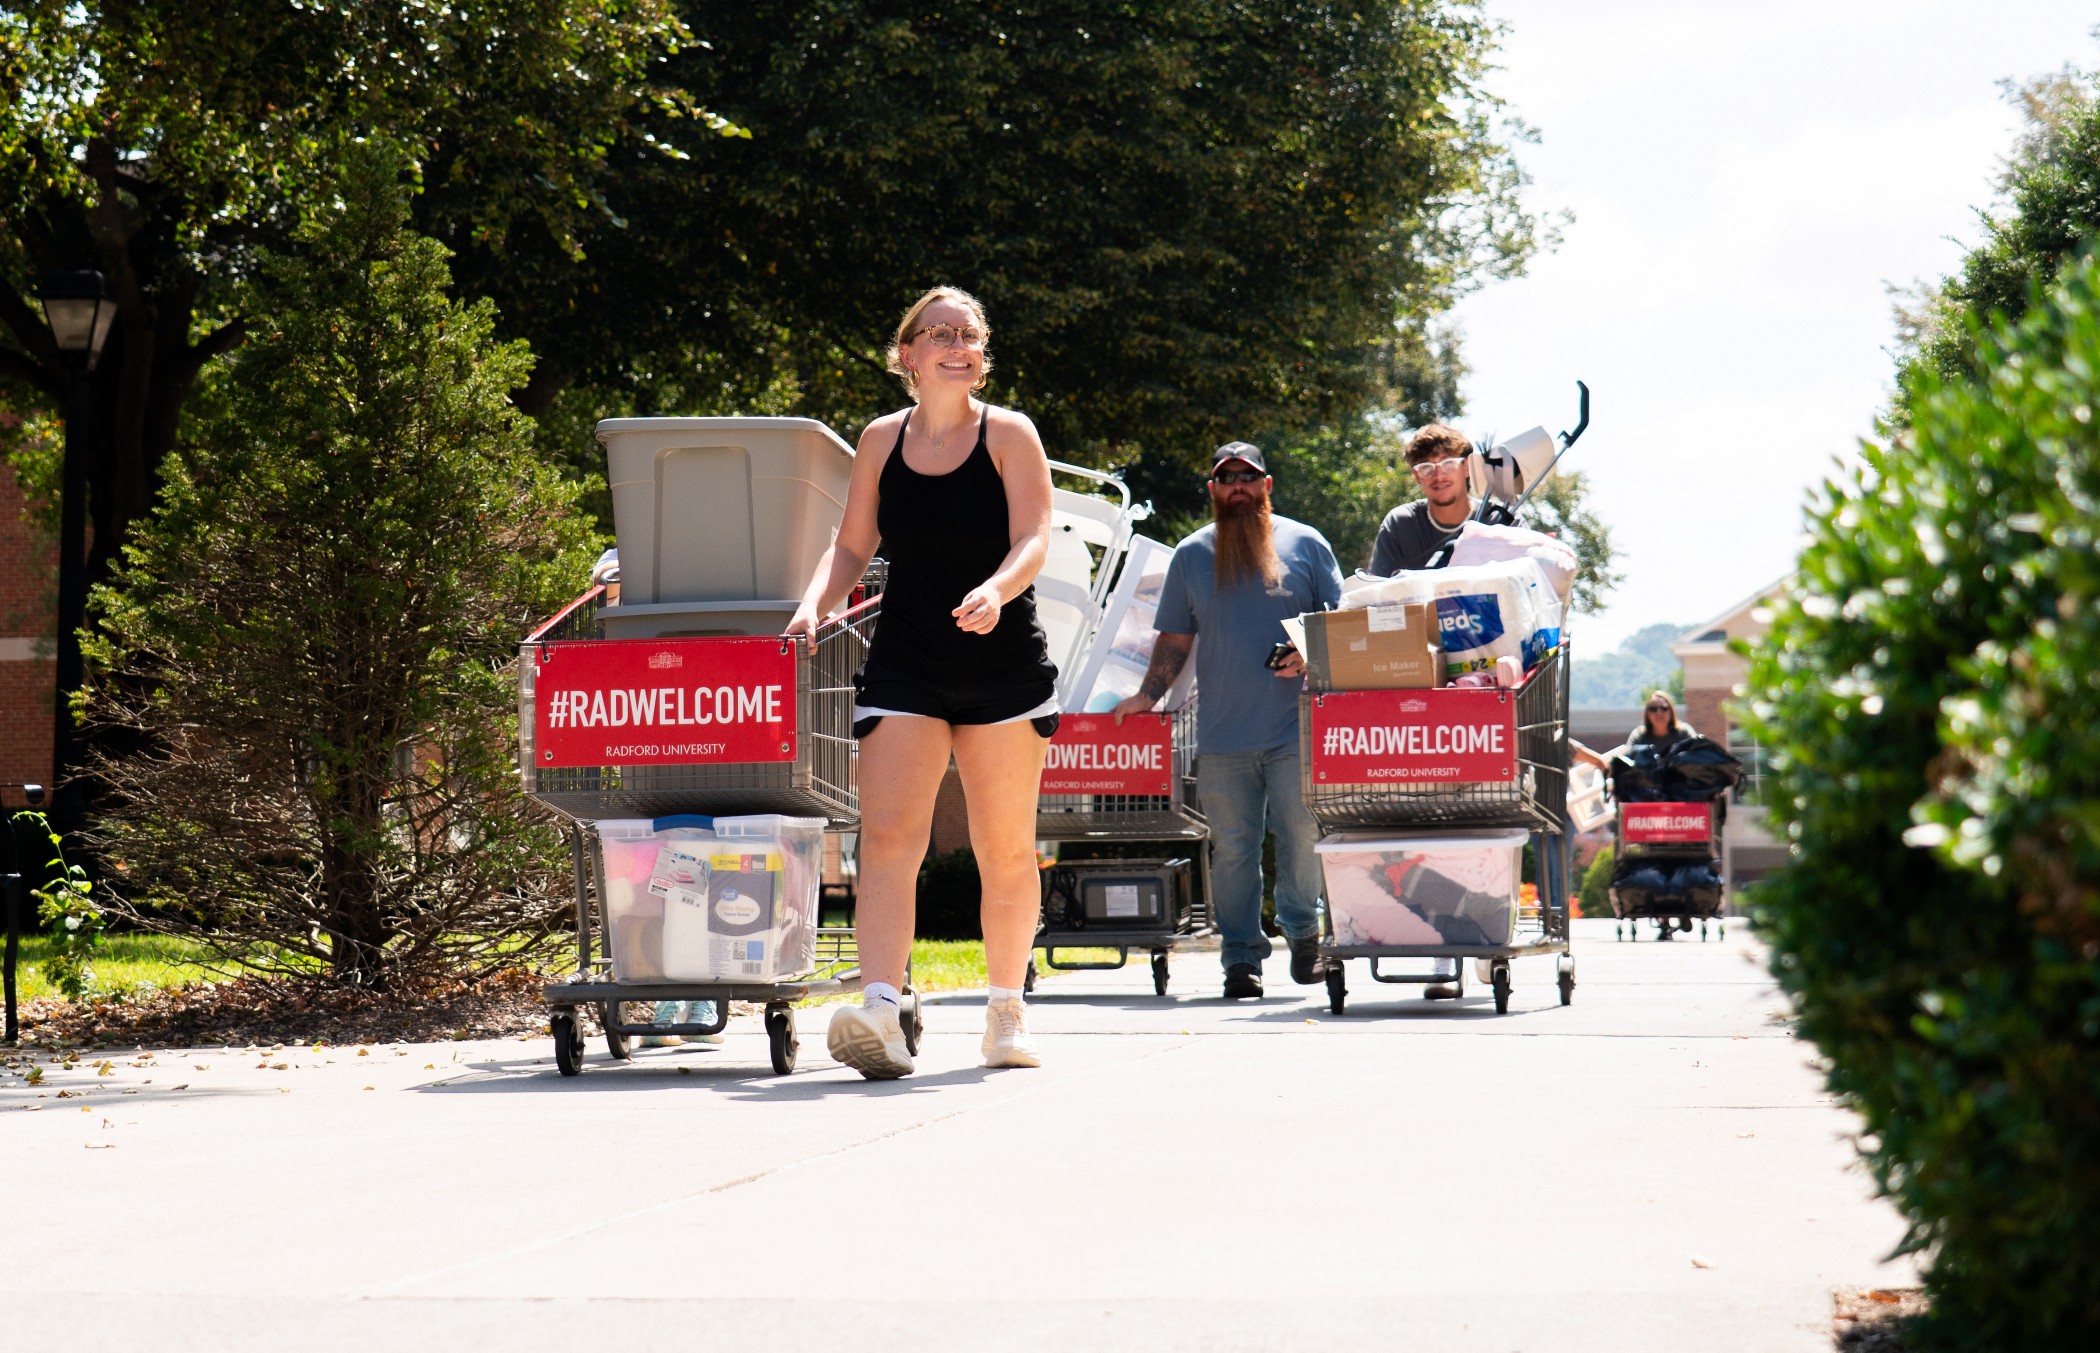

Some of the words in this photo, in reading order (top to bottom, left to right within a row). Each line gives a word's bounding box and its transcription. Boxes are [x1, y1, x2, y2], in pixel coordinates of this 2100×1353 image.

[1373, 663, 1388, 672] Ice
[1389, 661, 1420, 671] Maker
[1469, 657, 1489, 671] 24
[549, 685, 782, 727] #RADWELCOME
[1323, 724, 1504, 755] #RADWELCOME
[606, 745, 659, 757] RADFORD
[662, 743, 725, 756] UNIVERSITY
[1043, 744, 1162, 770] DWELCOME
[1367, 768, 1408, 777] RADFORD
[1411, 767, 1460, 777] UNIVERSITY
[1043, 781, 1080, 789] RADFORD
[1082, 781, 1125, 789] UNIVERSITY
[1627, 816, 1706, 830] #RADWELCOME
